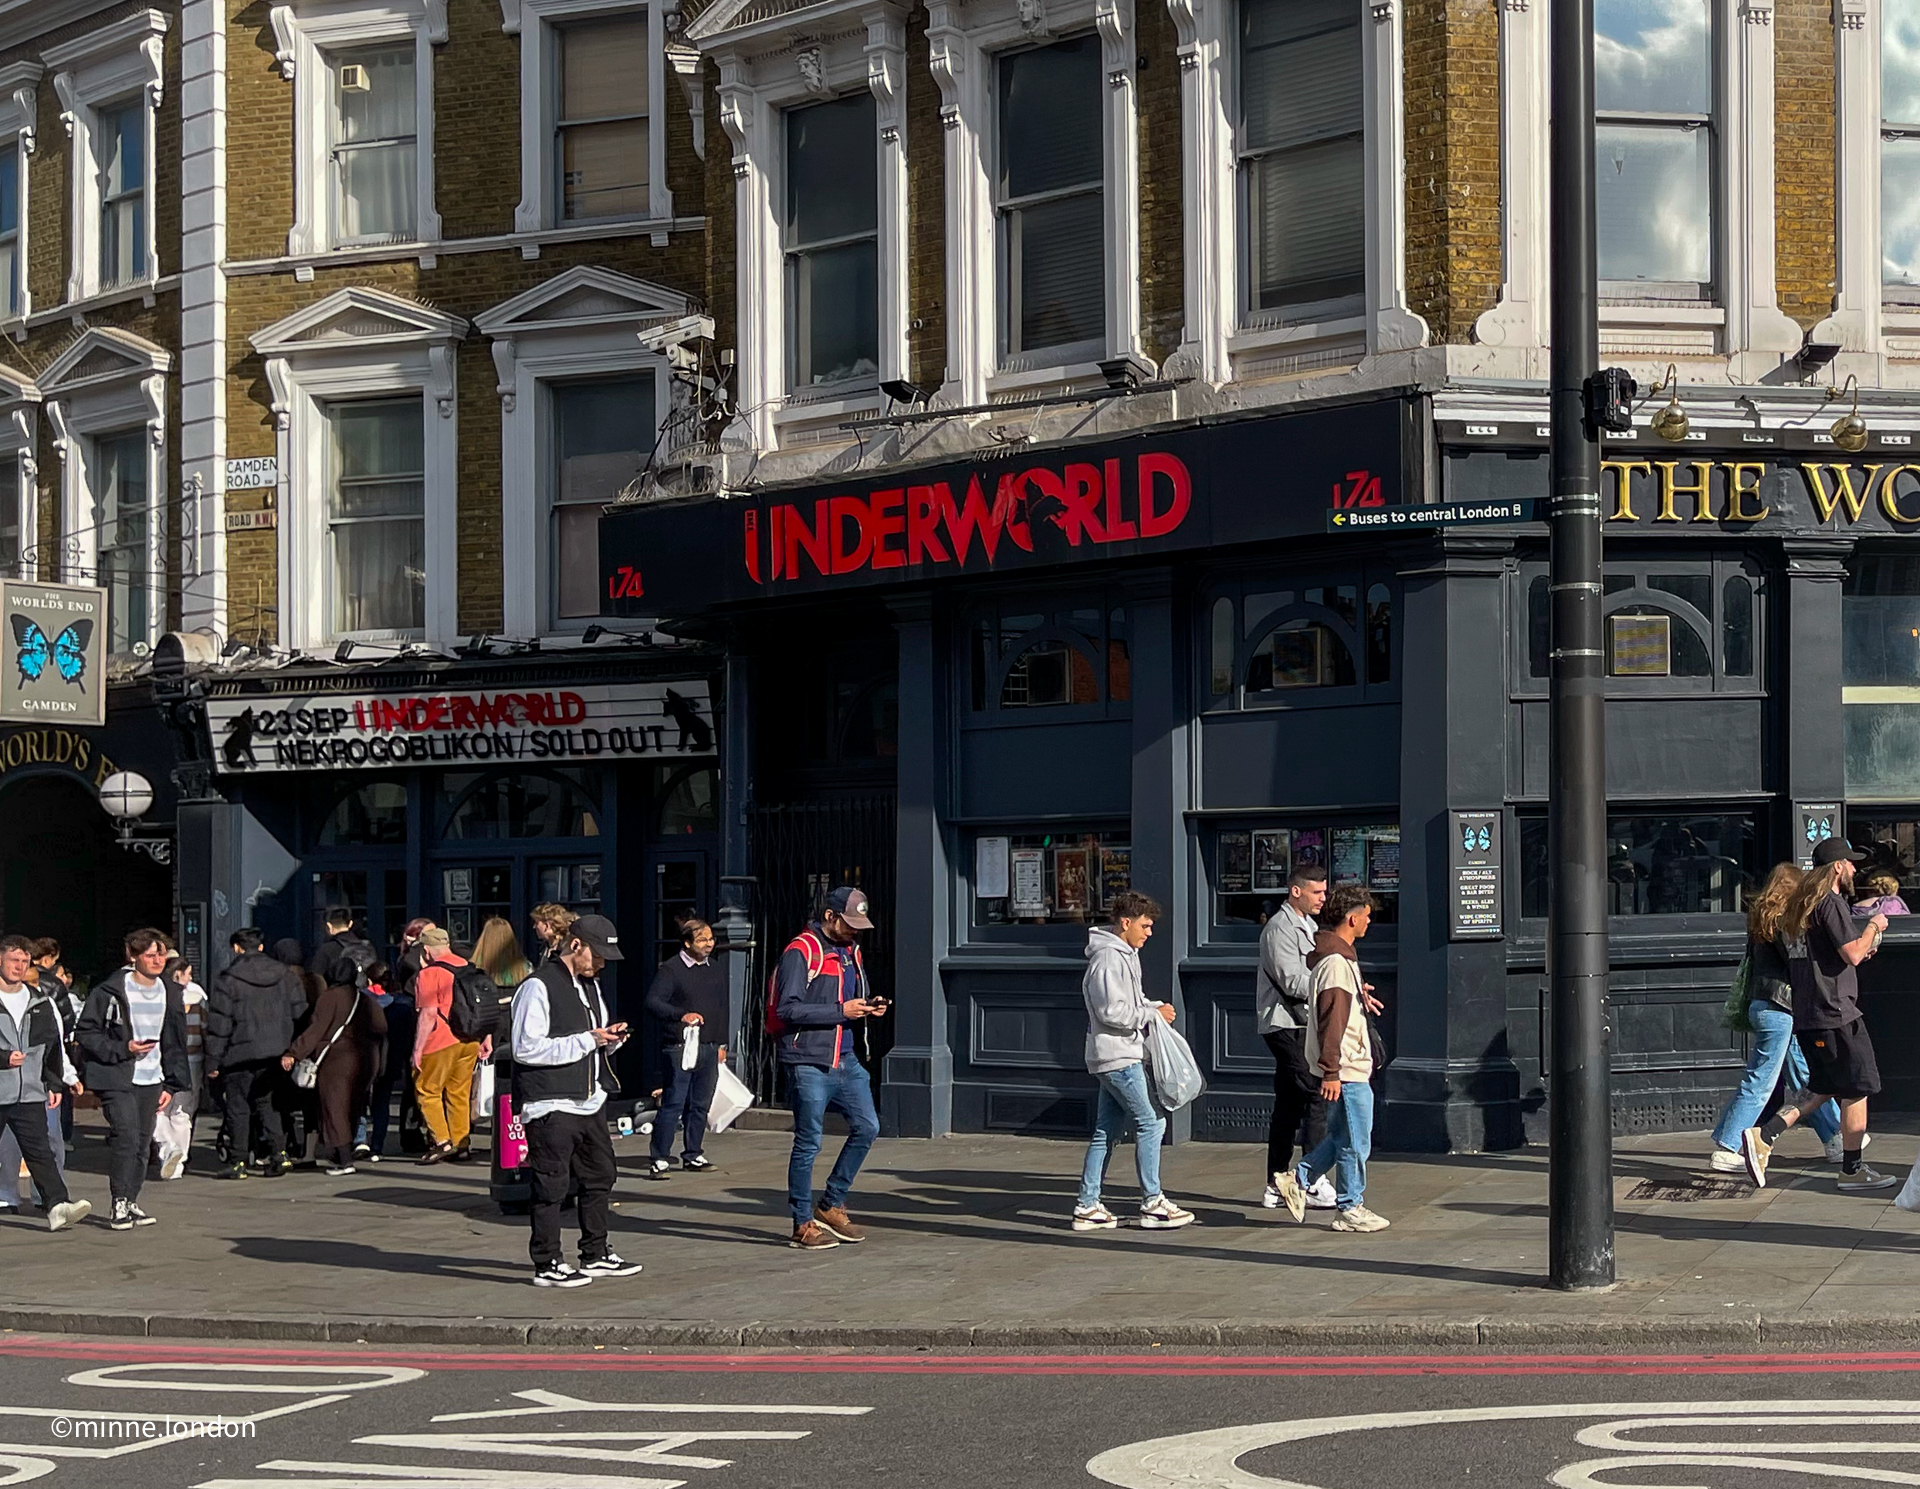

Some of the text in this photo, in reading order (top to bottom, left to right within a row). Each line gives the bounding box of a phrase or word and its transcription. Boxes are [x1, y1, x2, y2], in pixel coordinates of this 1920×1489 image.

[227, 459, 277, 473] CAMDEN
[227, 474, 260, 487] ROAD
[1600, 461, 1769, 521] THE
[229, 514, 251, 527] ROAD
[744, 453, 1192, 584] UNDERWORLD
[1350, 504, 1509, 525] Buses to central London
[12, 596, 94, 613] WORLDS END
[45, 592, 59, 600] THE
[22, 699, 77, 712] CAMDEN
[355, 692, 586, 732] UNDERWORLD
[609, 725, 664, 754] OUT
